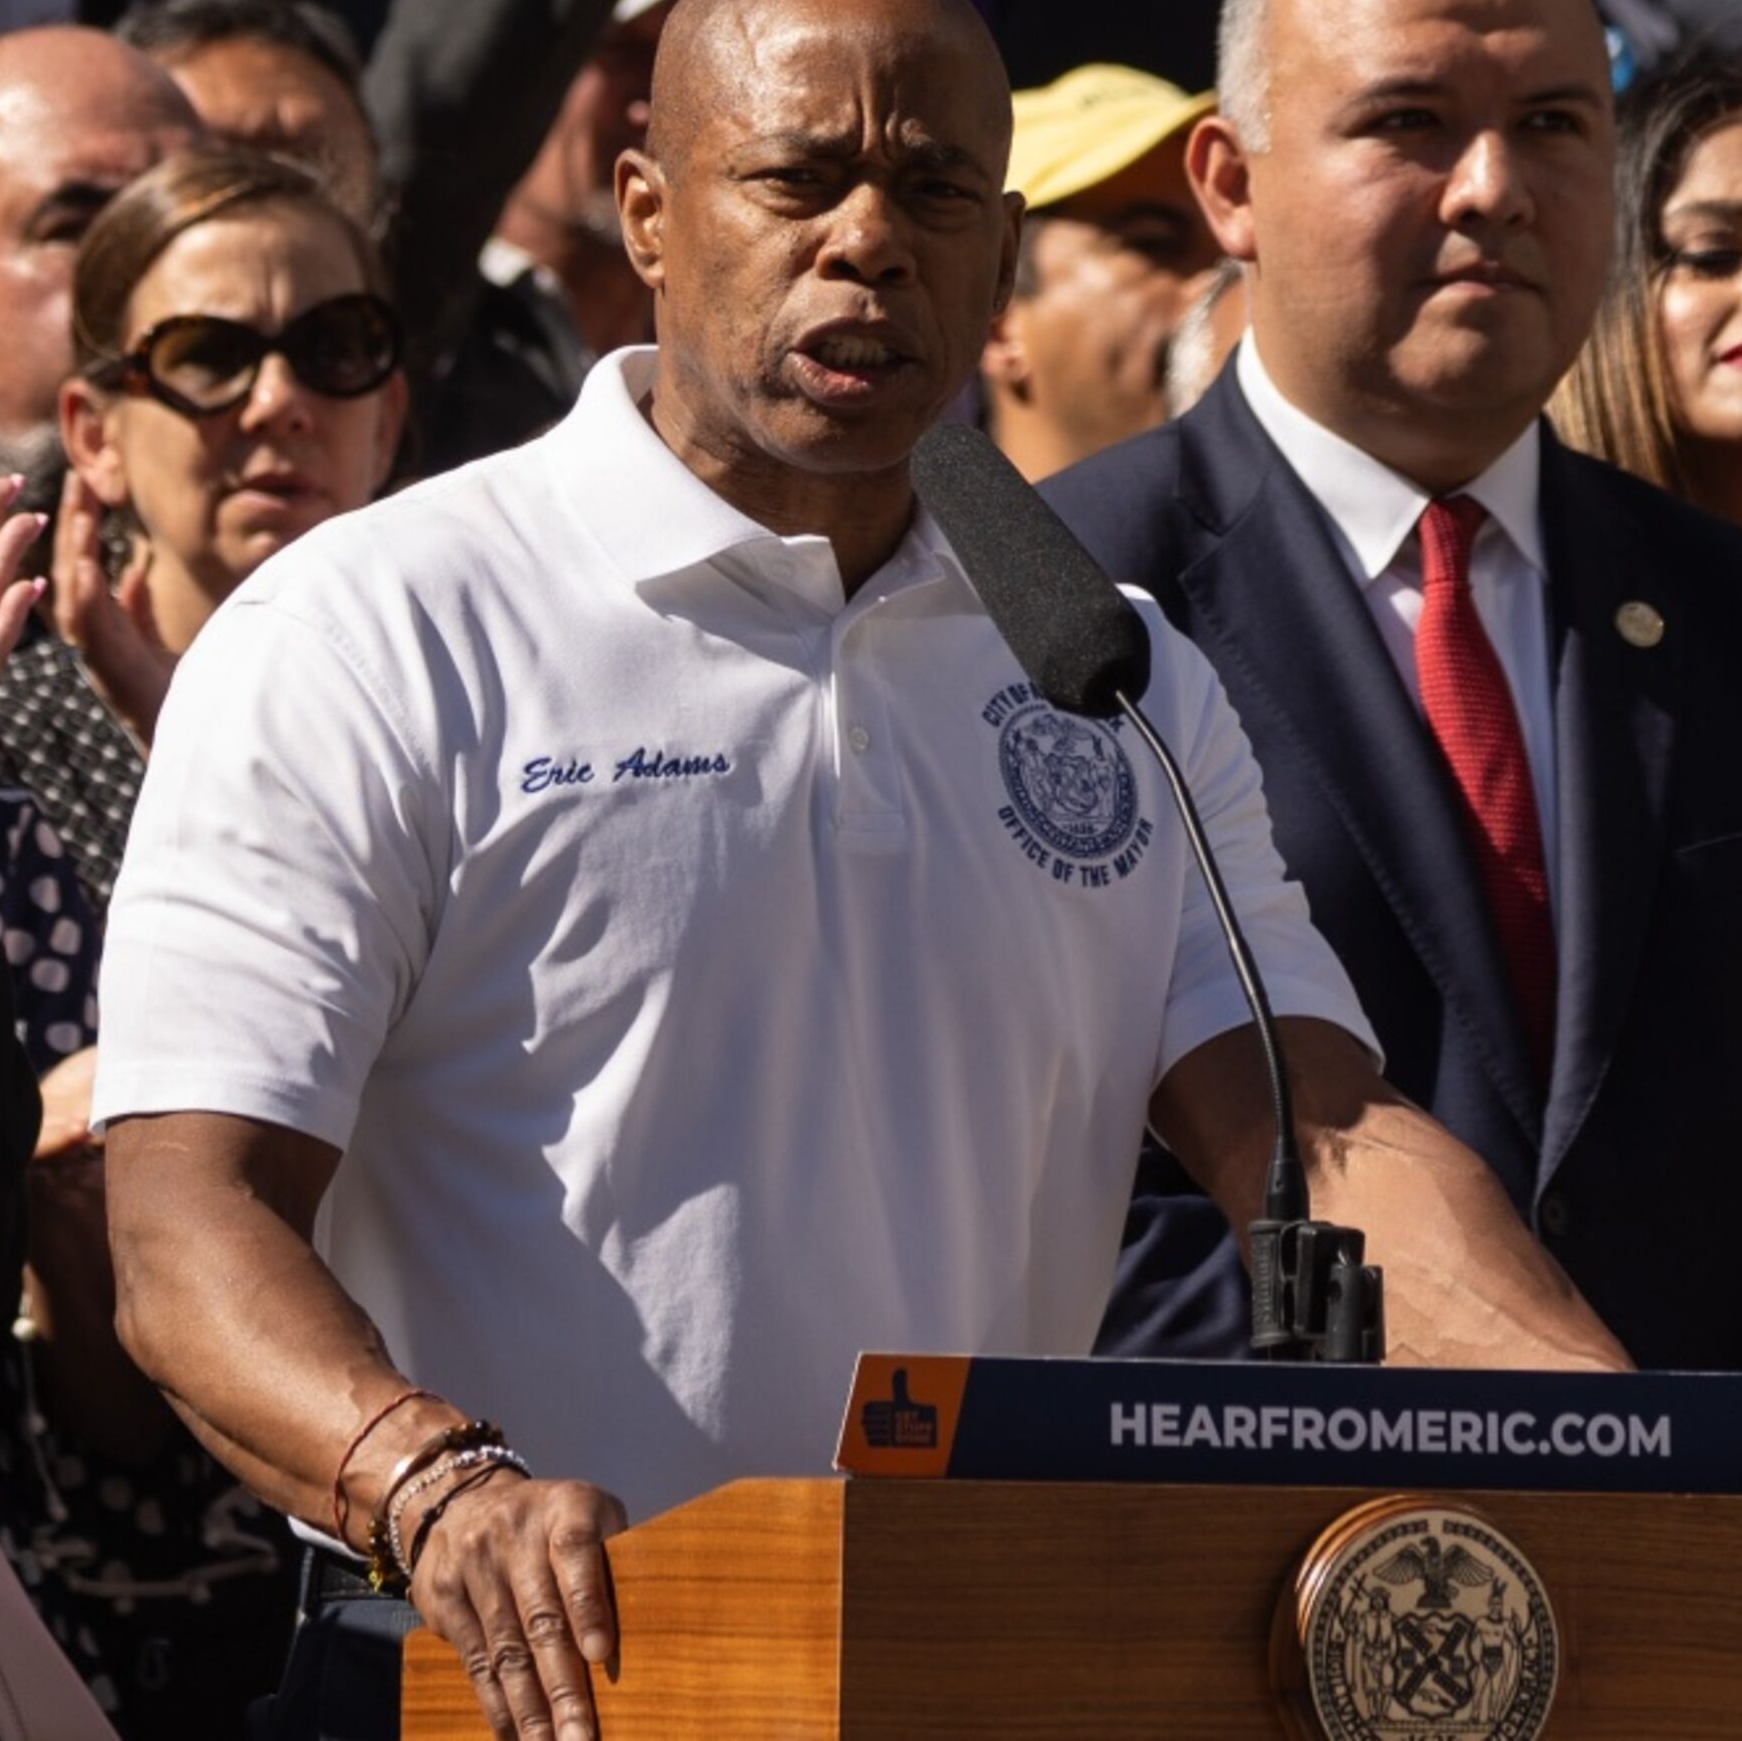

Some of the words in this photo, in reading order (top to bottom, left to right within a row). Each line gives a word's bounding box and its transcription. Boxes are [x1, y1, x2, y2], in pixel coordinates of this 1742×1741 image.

[982, 689, 1012, 729] CITY
[1008, 682, 1030, 706] OF
[519, 754, 596, 795] Eric
[612, 745, 732, 782] Adams
[997, 804, 1051, 870] OFFICE
[1051, 859, 1075, 885] OF
[1079, 864, 1111, 888] THE
[1113, 817, 1155, 879] MAYOR
[1108, 1400, 1672, 1459] HEARFROMERIC.COM
